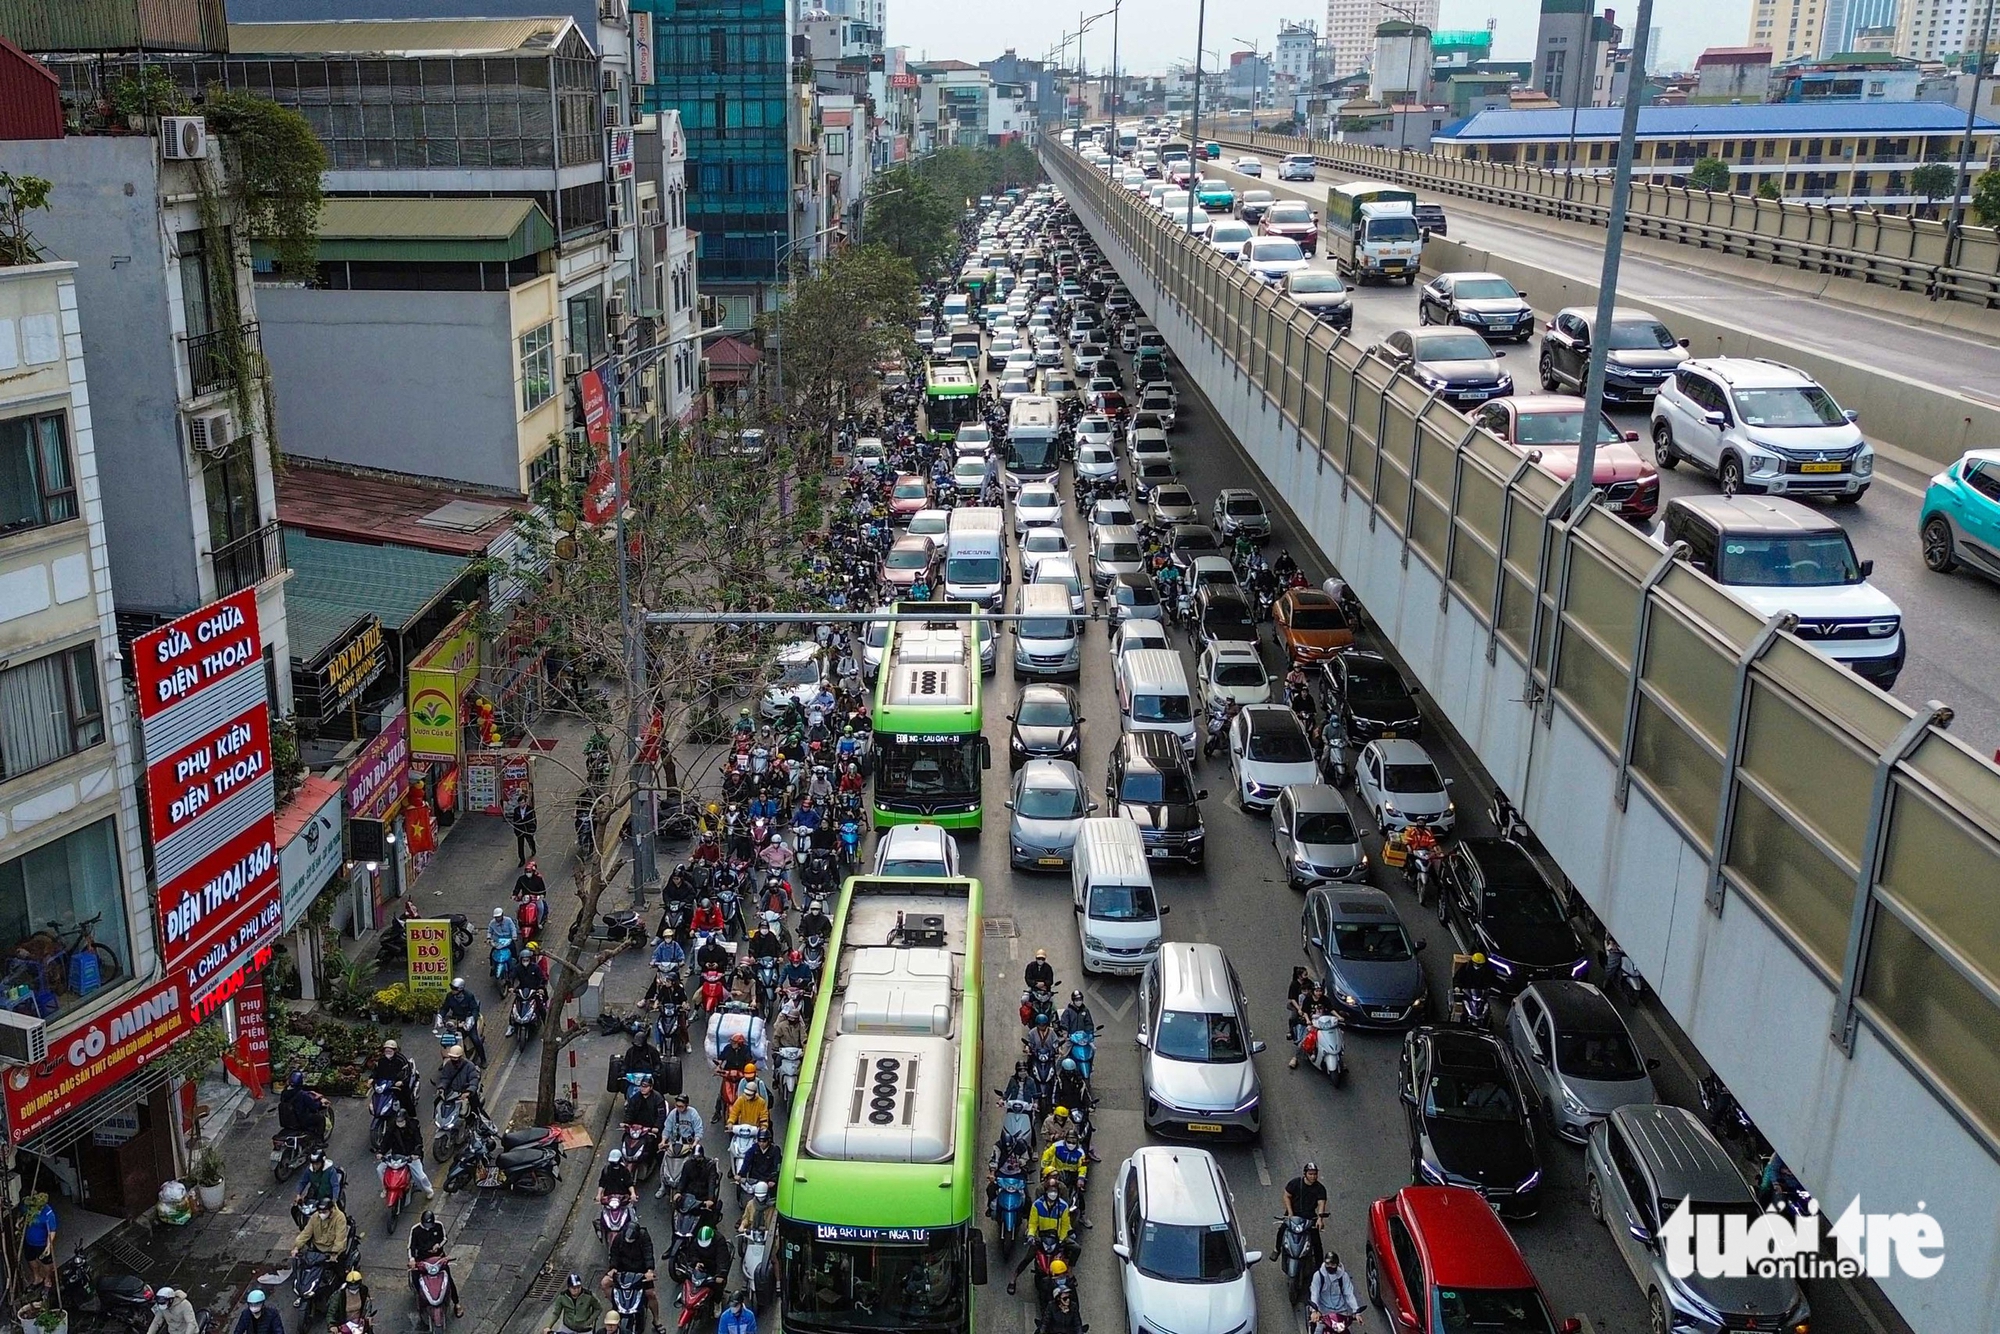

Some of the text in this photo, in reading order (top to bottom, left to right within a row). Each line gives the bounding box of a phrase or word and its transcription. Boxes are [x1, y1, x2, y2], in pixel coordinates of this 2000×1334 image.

[157, 606, 244, 663] SỬA CHỮA
[159, 637, 252, 701] ĐIỆN THOẠI
[178, 724, 250, 783] PHỤ KIỆN
[171, 751, 262, 823] ĐIỆN THOẠI
[352, 773, 373, 810] BÚN
[167, 889, 200, 943] ĐIỆN
[204, 859, 246, 915] THOẠI
[199, 943, 228, 977] CHỮA
[230, 935, 238, 952] &
[240, 919, 259, 945] PHỤ
[261, 900, 281, 928] KIỆN
[410, 926, 446, 941] BÚN
[417, 943, 440, 957] BÒ
[412, 958, 448, 973] HUẾ
[68, 1025, 106, 1067] CÔ
[110, 985, 179, 1046] MINH
[240, 1000, 260, 1011] PHỤ
[54, 1088, 59, 1100] &
